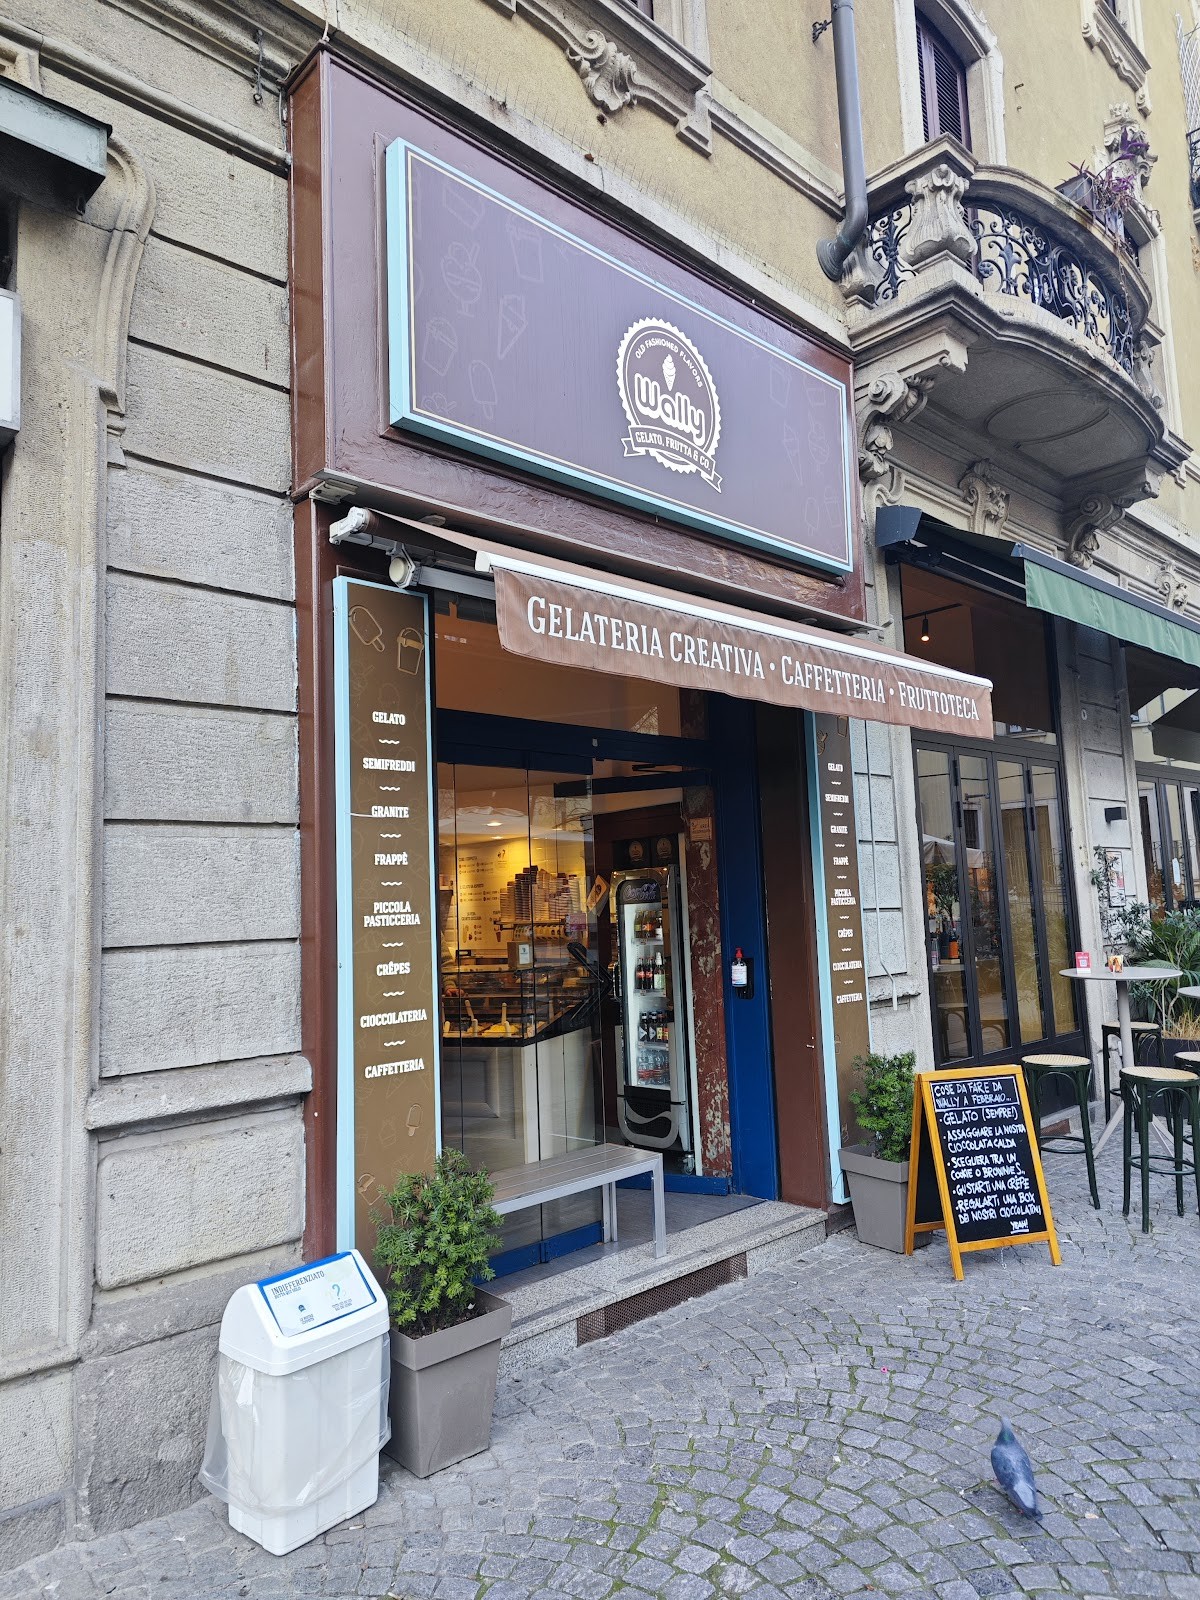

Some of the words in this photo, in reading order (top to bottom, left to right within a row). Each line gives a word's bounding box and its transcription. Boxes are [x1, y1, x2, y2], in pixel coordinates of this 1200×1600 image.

[635, 344, 646, 359] OLD
[645, 337, 679, 353] FASHIONED
[679, 350, 703, 388] FLAVORS
[665, 436, 692, 458] FRUTTA
[692, 449, 699, 461] &
[699, 455, 711, 471] CO.
[669, 631, 765, 680] CREATIVA
[781, 655, 886, 704] CAFFETTERIA
[898, 681, 980, 721] FRUTTOTECA
[372, 711, 406, 726] GELATO
[362, 757, 416, 772] SEMIFREDDI
[371, 805, 409, 819] GRANITE
[373, 901, 412, 914] PICCOLA
[363, 913, 421, 928] PASTICCERIA
[360, 1008, 428, 1029] CIOCCOLATERIA
[364, 1057, 425, 1079] CAFFETTERIA
[934, 1084, 955, 1097] COSE
[956, 1083, 968, 1095] DA
[967, 1081, 990, 1094] FARE
[992, 1081, 1003, 1092] DA
[935, 1096, 960, 1109] WALLY
[963, 1095, 969, 1107] A
[943, 1110, 979, 1126] GELATO
[946, 1126, 994, 1143] ASSAGGIARE
[994, 1126, 1004, 1137] LA
[1003, 1123, 1027, 1135] NOSTRA
[947, 1138, 994, 1154] CIOCCOLATA
[993, 1137, 1017, 1149] CALDA
[989, 1153, 1005, 1165] TRA
[1006, 1152, 1017, 1164] UN
[950, 1168, 974, 1181] COOKIE
[991, 1179, 1007, 1191] UNA
[957, 1194, 1000, 1213] REGALARTI
[1002, 1193, 1018, 1204] UNA
[1018, 1191, 1035, 1204] BOX
[970, 1208, 998, 1222] NOSTRI
[1010, 1218, 1029, 1230] YEAH!
[271, 1270, 325, 1295] INDIFFERENZIATO
